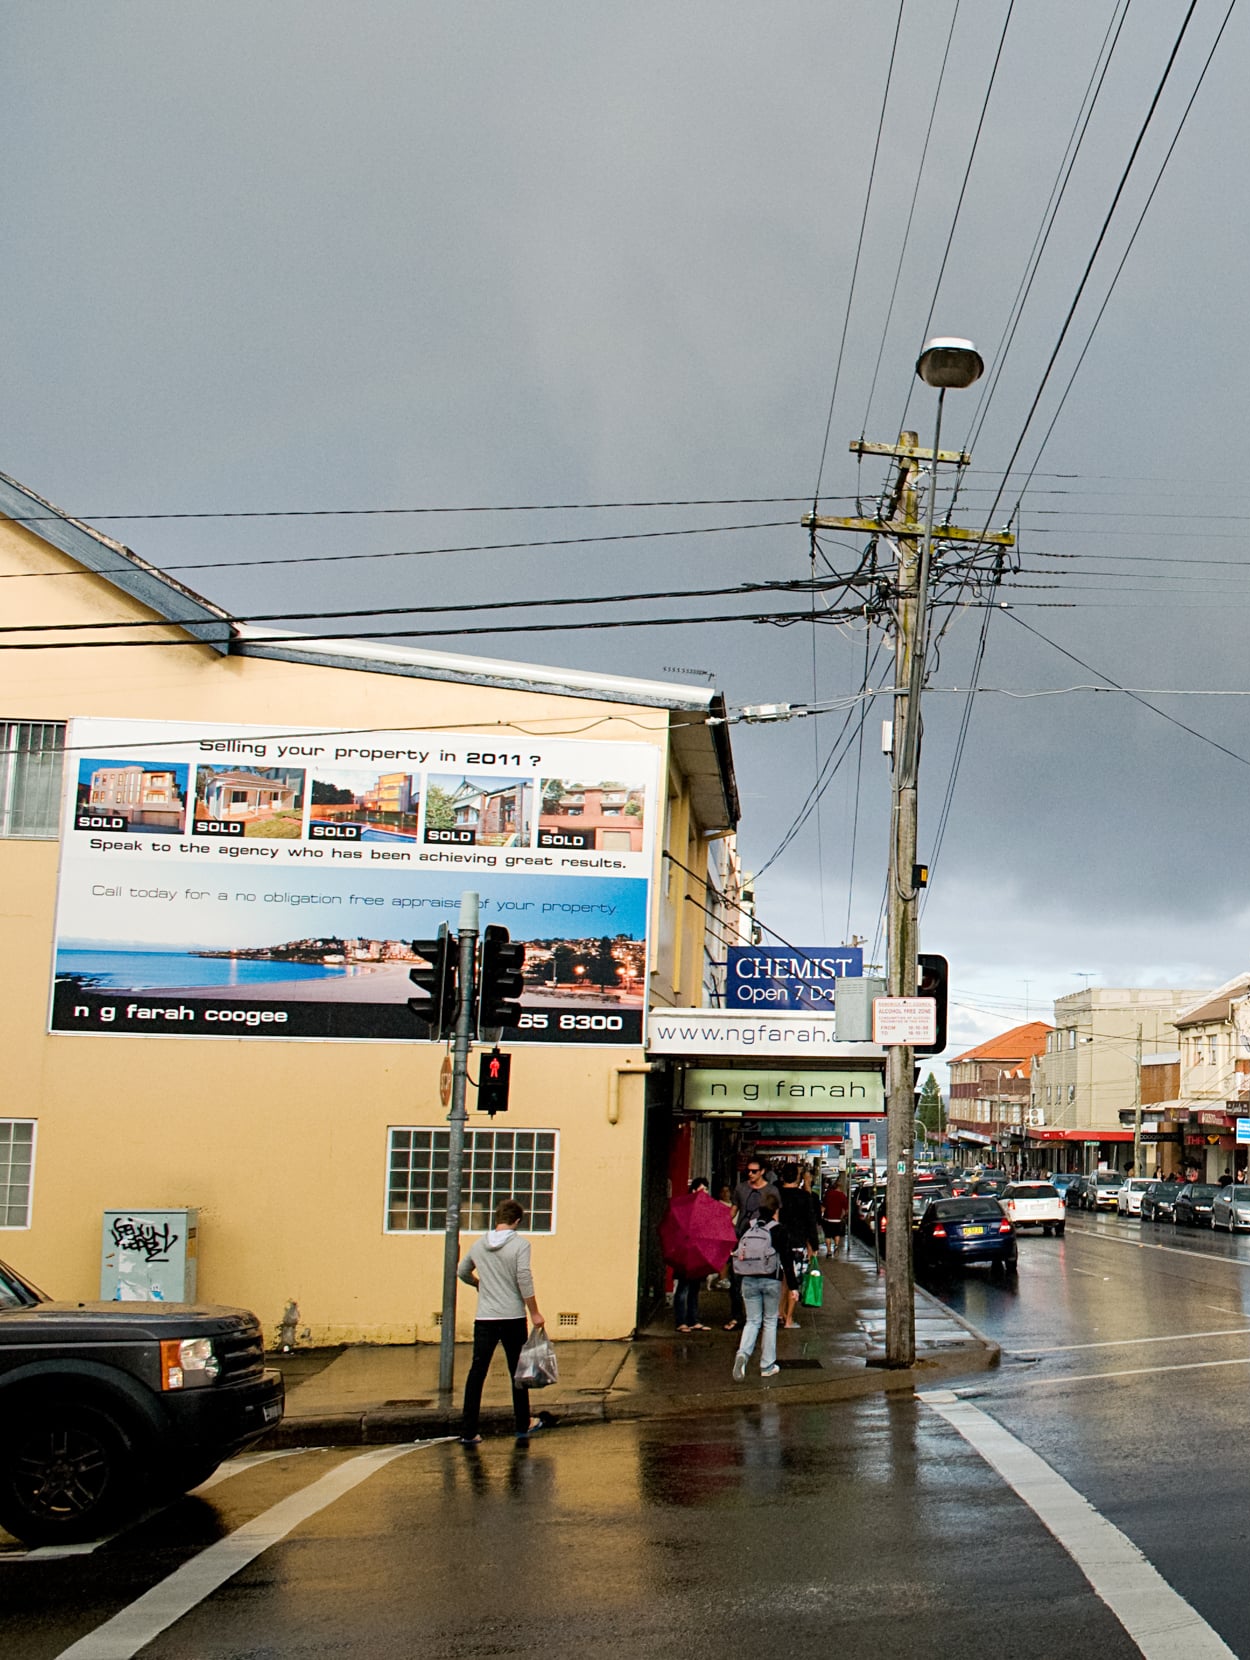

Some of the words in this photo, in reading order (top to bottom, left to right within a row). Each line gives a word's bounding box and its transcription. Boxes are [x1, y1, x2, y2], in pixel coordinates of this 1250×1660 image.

[200, 740, 266, 757] Selling
[278, 744, 325, 758] your
[335, 747, 429, 764] property
[440, 750, 456, 762] in
[78, 816, 124, 829] SOLD
[196, 821, 241, 833] SOLD
[313, 825, 357, 838] SOLD
[428, 830, 472, 842] SOLD
[541, 834, 584, 847] SOLD
[90, 838, 142, 853] Speak
[152, 842, 171, 853] to
[180, 843, 210, 855] the
[219, 845, 279, 859] agency
[288, 846, 324, 859] who
[332, 848, 363, 860] has
[371, 849, 411, 861] been
[419, 851, 497, 867] achieving
[505, 855, 553, 868] great
[561, 857, 626, 869] results.
[92, 885, 122, 898] Call
[130, 887, 178, 902] today
[185, 889, 210, 900] for
[218, 891, 228, 901] a
[236, 892, 256, 903] no
[264, 892, 342, 906] obligation
[349, 894, 385, 906] free
[497, 901, 535, 912] your
[736, 957, 852, 979] CHEMIST
[737, 985, 788, 1003] Open
[794, 986, 803, 1000] 7
[74, 1005, 89, 1017] n
[101, 1006, 116, 1021] g
[126, 1004, 195, 1020] farah
[204, 1008, 288, 1026] coogee
[559, 1015, 623, 1031] 8300
[711, 1083, 728, 1096] n
[743, 1083, 759, 1101] g
[776, 1080, 866, 1098] farah
